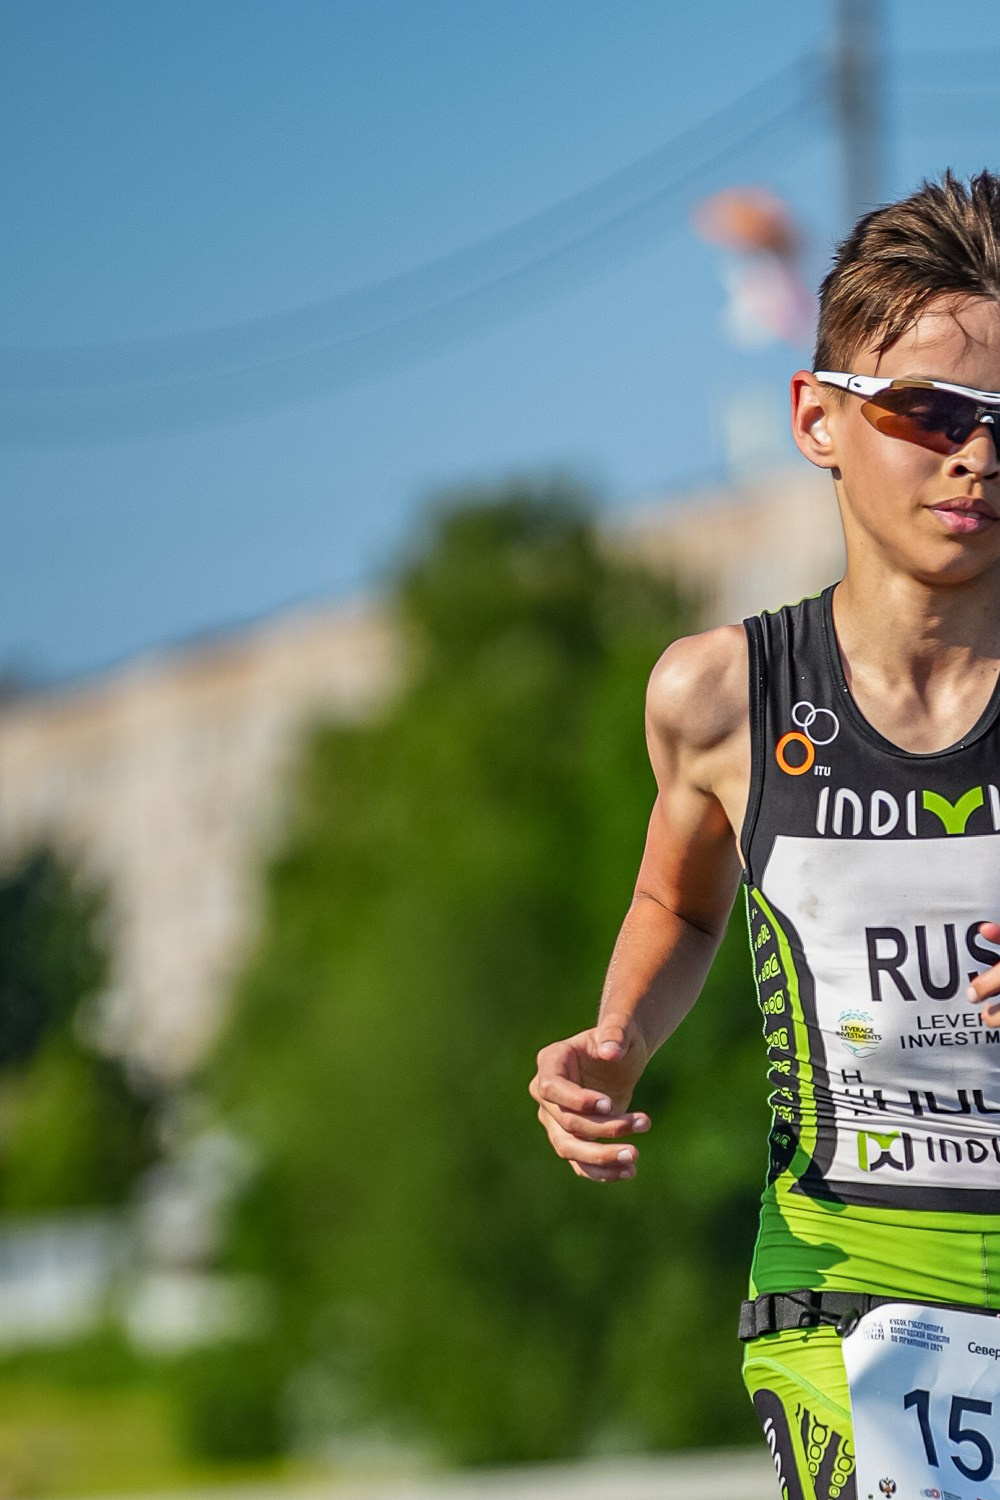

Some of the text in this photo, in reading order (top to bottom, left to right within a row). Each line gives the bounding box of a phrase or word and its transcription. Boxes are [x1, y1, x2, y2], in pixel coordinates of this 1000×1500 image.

[814, 765, 831, 777] ITU
[835, 1030, 883, 1041] INVESTMENTS
[840, 1025, 874, 1035] LEVERAGE
